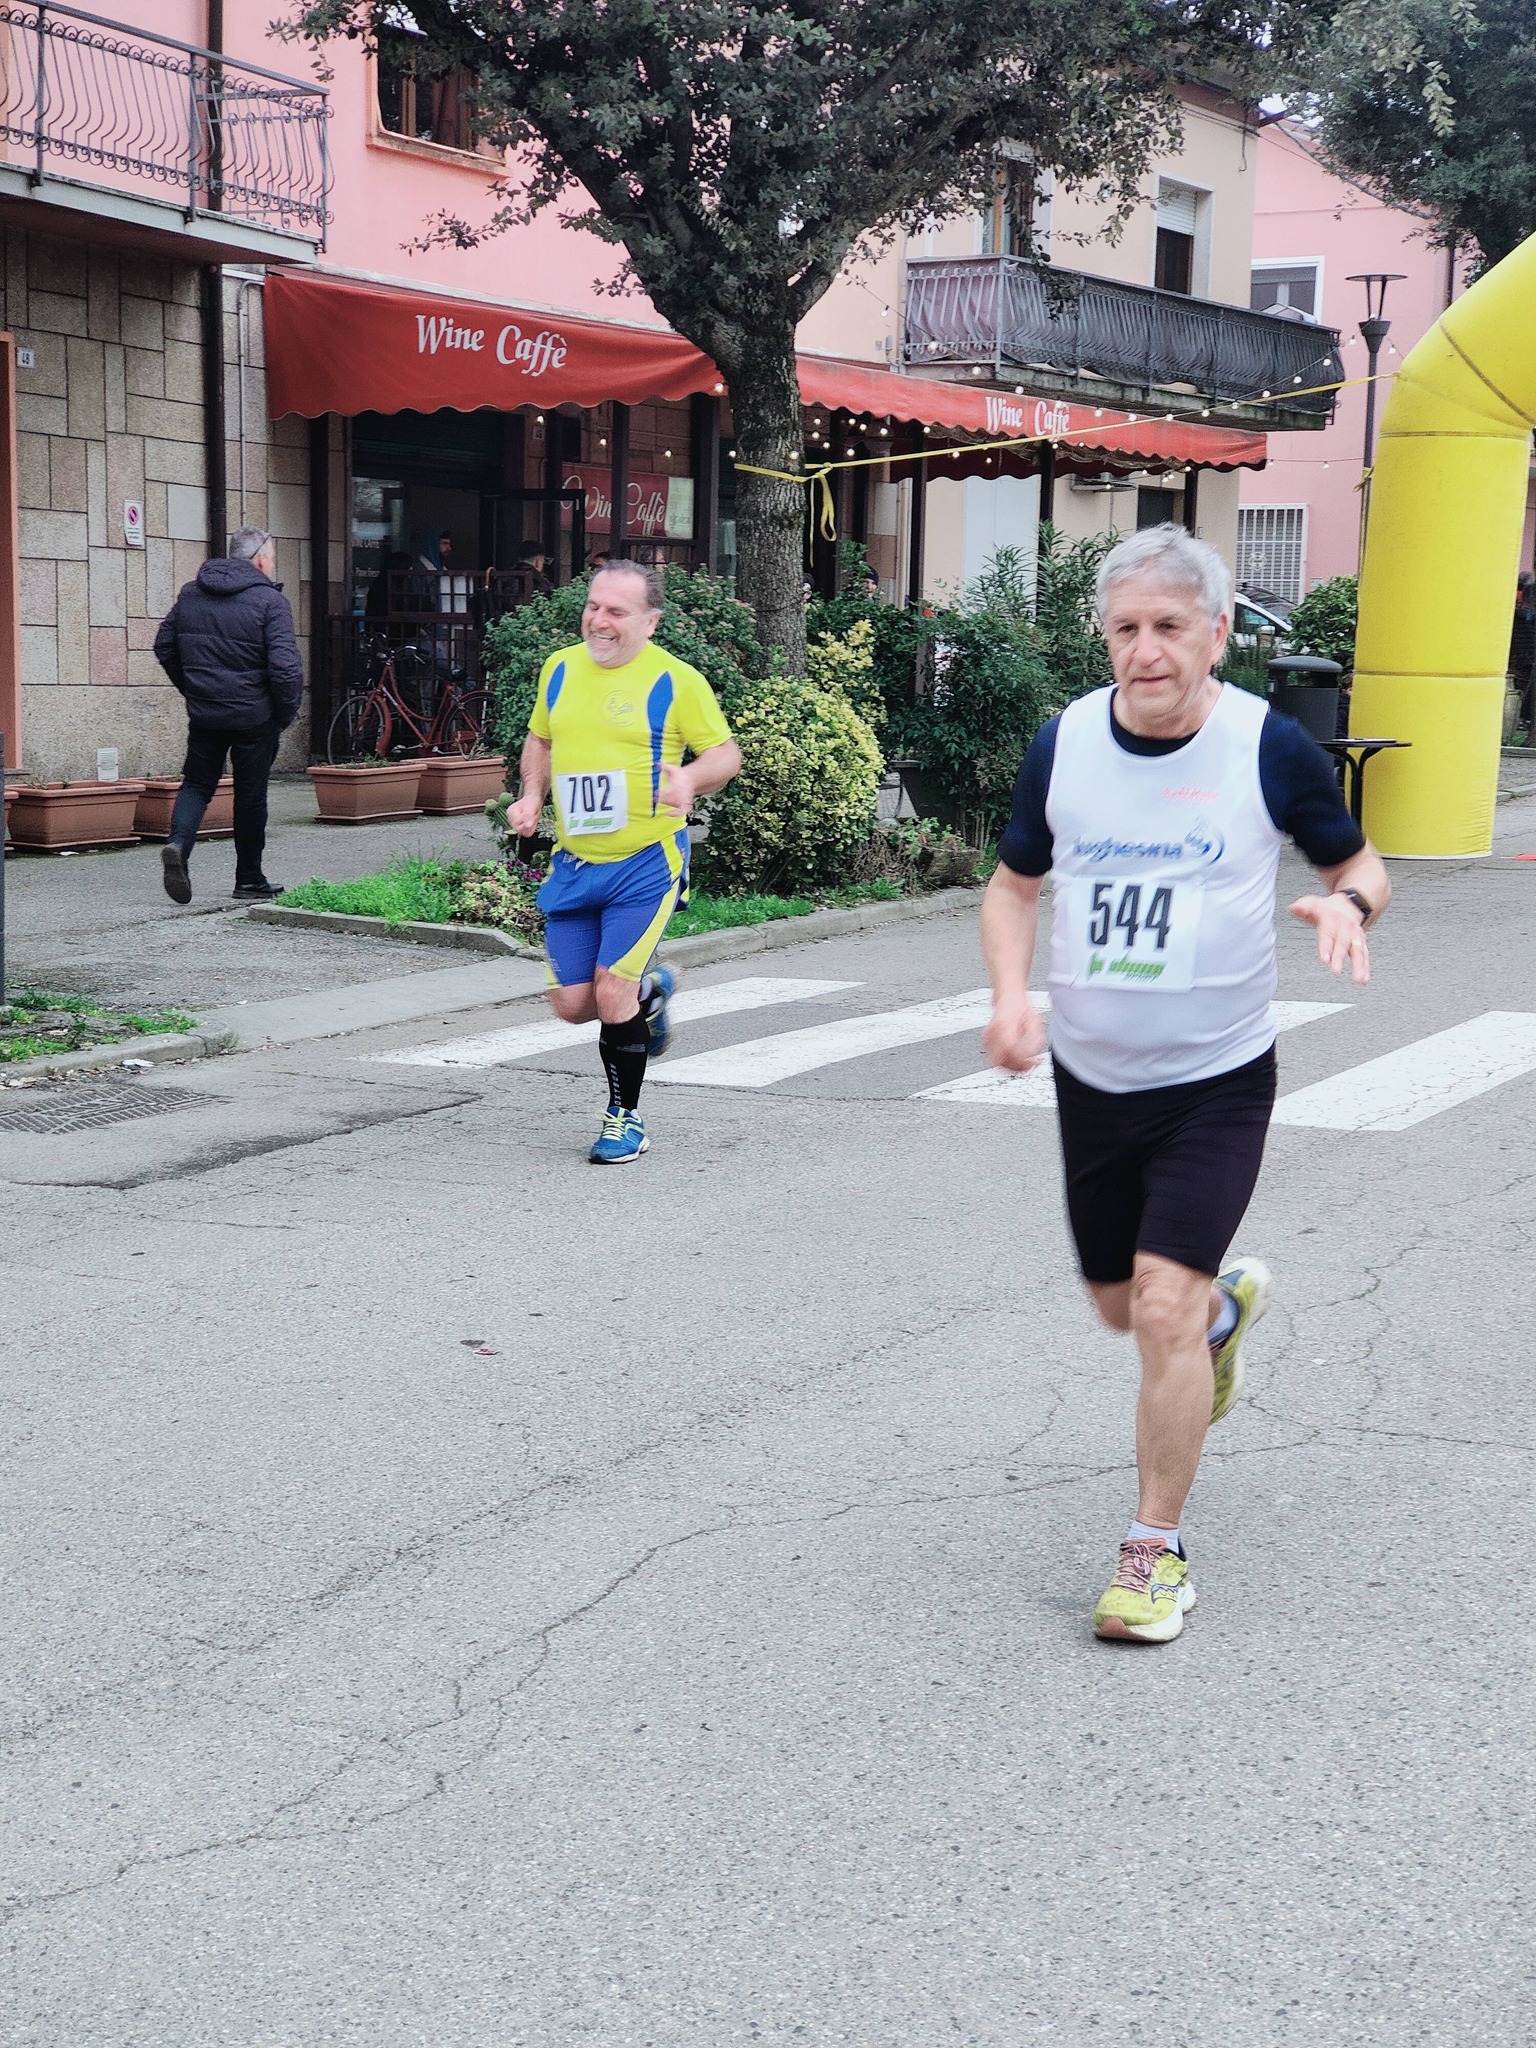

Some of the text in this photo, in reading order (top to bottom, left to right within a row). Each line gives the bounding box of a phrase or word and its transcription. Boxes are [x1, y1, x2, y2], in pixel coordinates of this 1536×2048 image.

[415, 314, 568, 377] Wine Caffè
[985, 396, 1070, 443] Wine Caffè
[560, 475, 612, 520] Win
[568, 775, 613, 813] 702
[1089, 883, 1175, 949] 544
